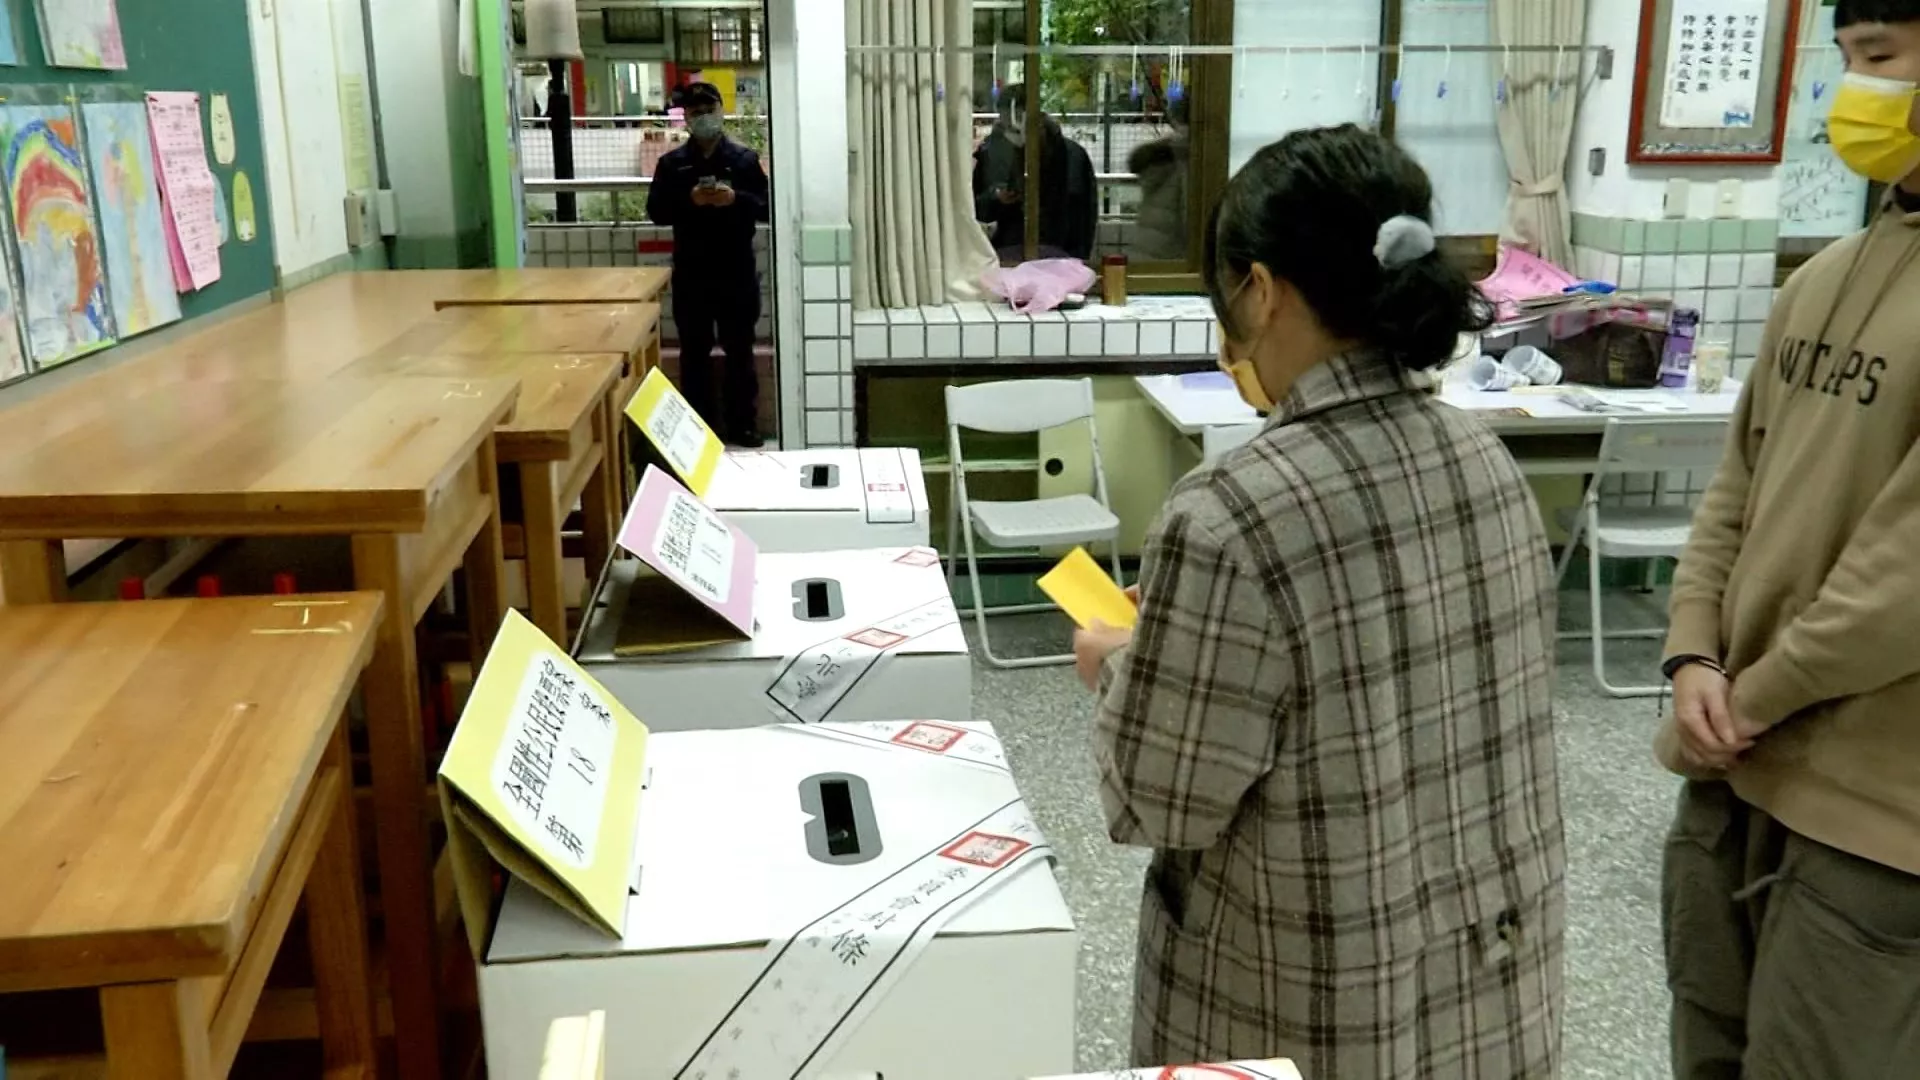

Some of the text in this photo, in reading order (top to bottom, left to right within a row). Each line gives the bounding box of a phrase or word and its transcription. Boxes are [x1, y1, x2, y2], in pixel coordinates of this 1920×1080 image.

[503, 659, 576, 820] 全國性公民投票案
[545, 692, 611, 862] 第 18 案
